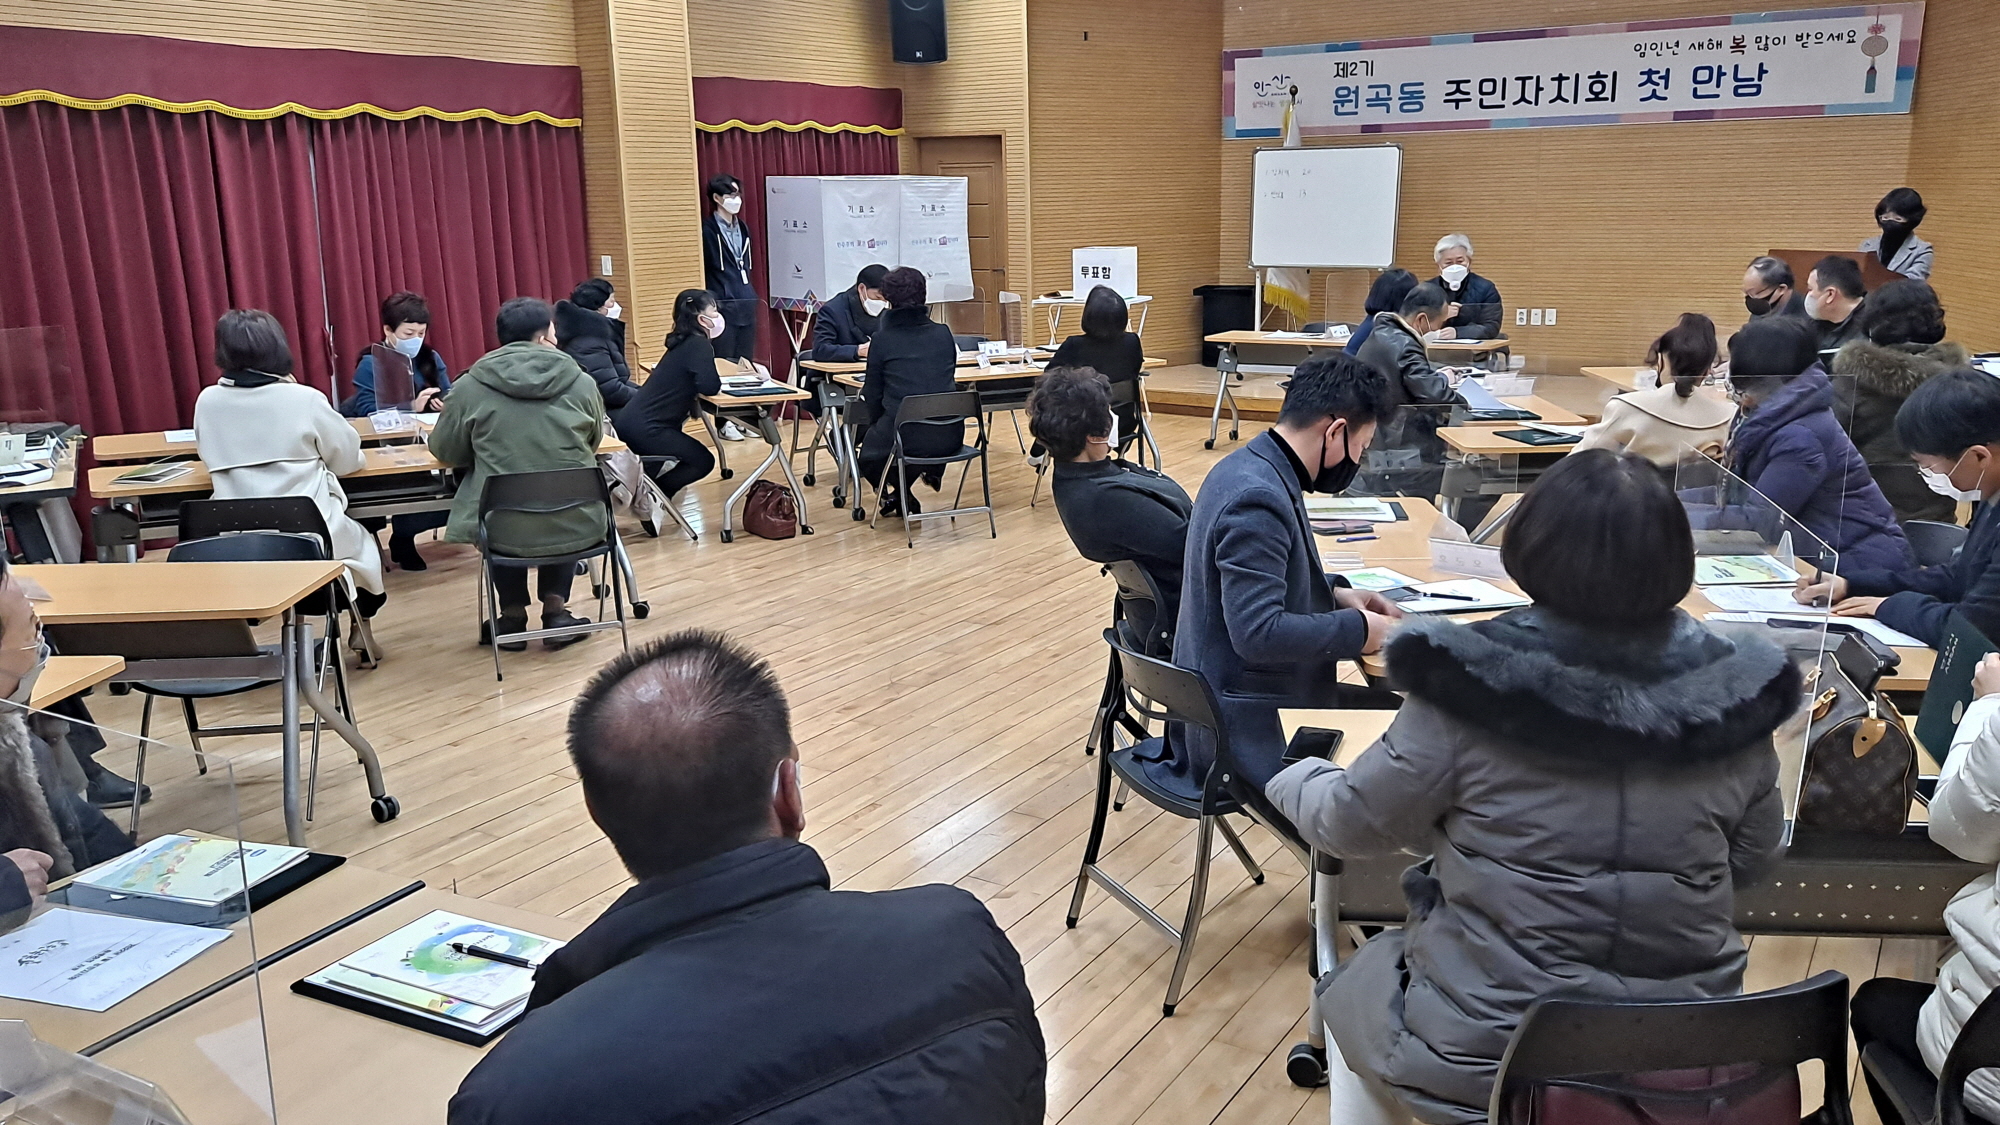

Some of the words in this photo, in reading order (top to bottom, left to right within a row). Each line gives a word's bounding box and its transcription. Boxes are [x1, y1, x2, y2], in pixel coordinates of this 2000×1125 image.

[1633, 39, 1680, 59] 임인년
[1687, 37, 1723, 51] 새해
[1729, 34, 1748, 56] 복
[1754, 34, 1787, 52] 많이
[1795, 29, 1857, 49] 받으세요
[1333, 59, 1374, 79] 제2기
[1332, 81, 1427, 117] 원곡동
[1442, 70, 1618, 111] 주민자치회
[1637, 67, 1671, 103] 첫
[1691, 61, 1770, 100] 만남
[1081, 266, 1111, 280] 투표함
